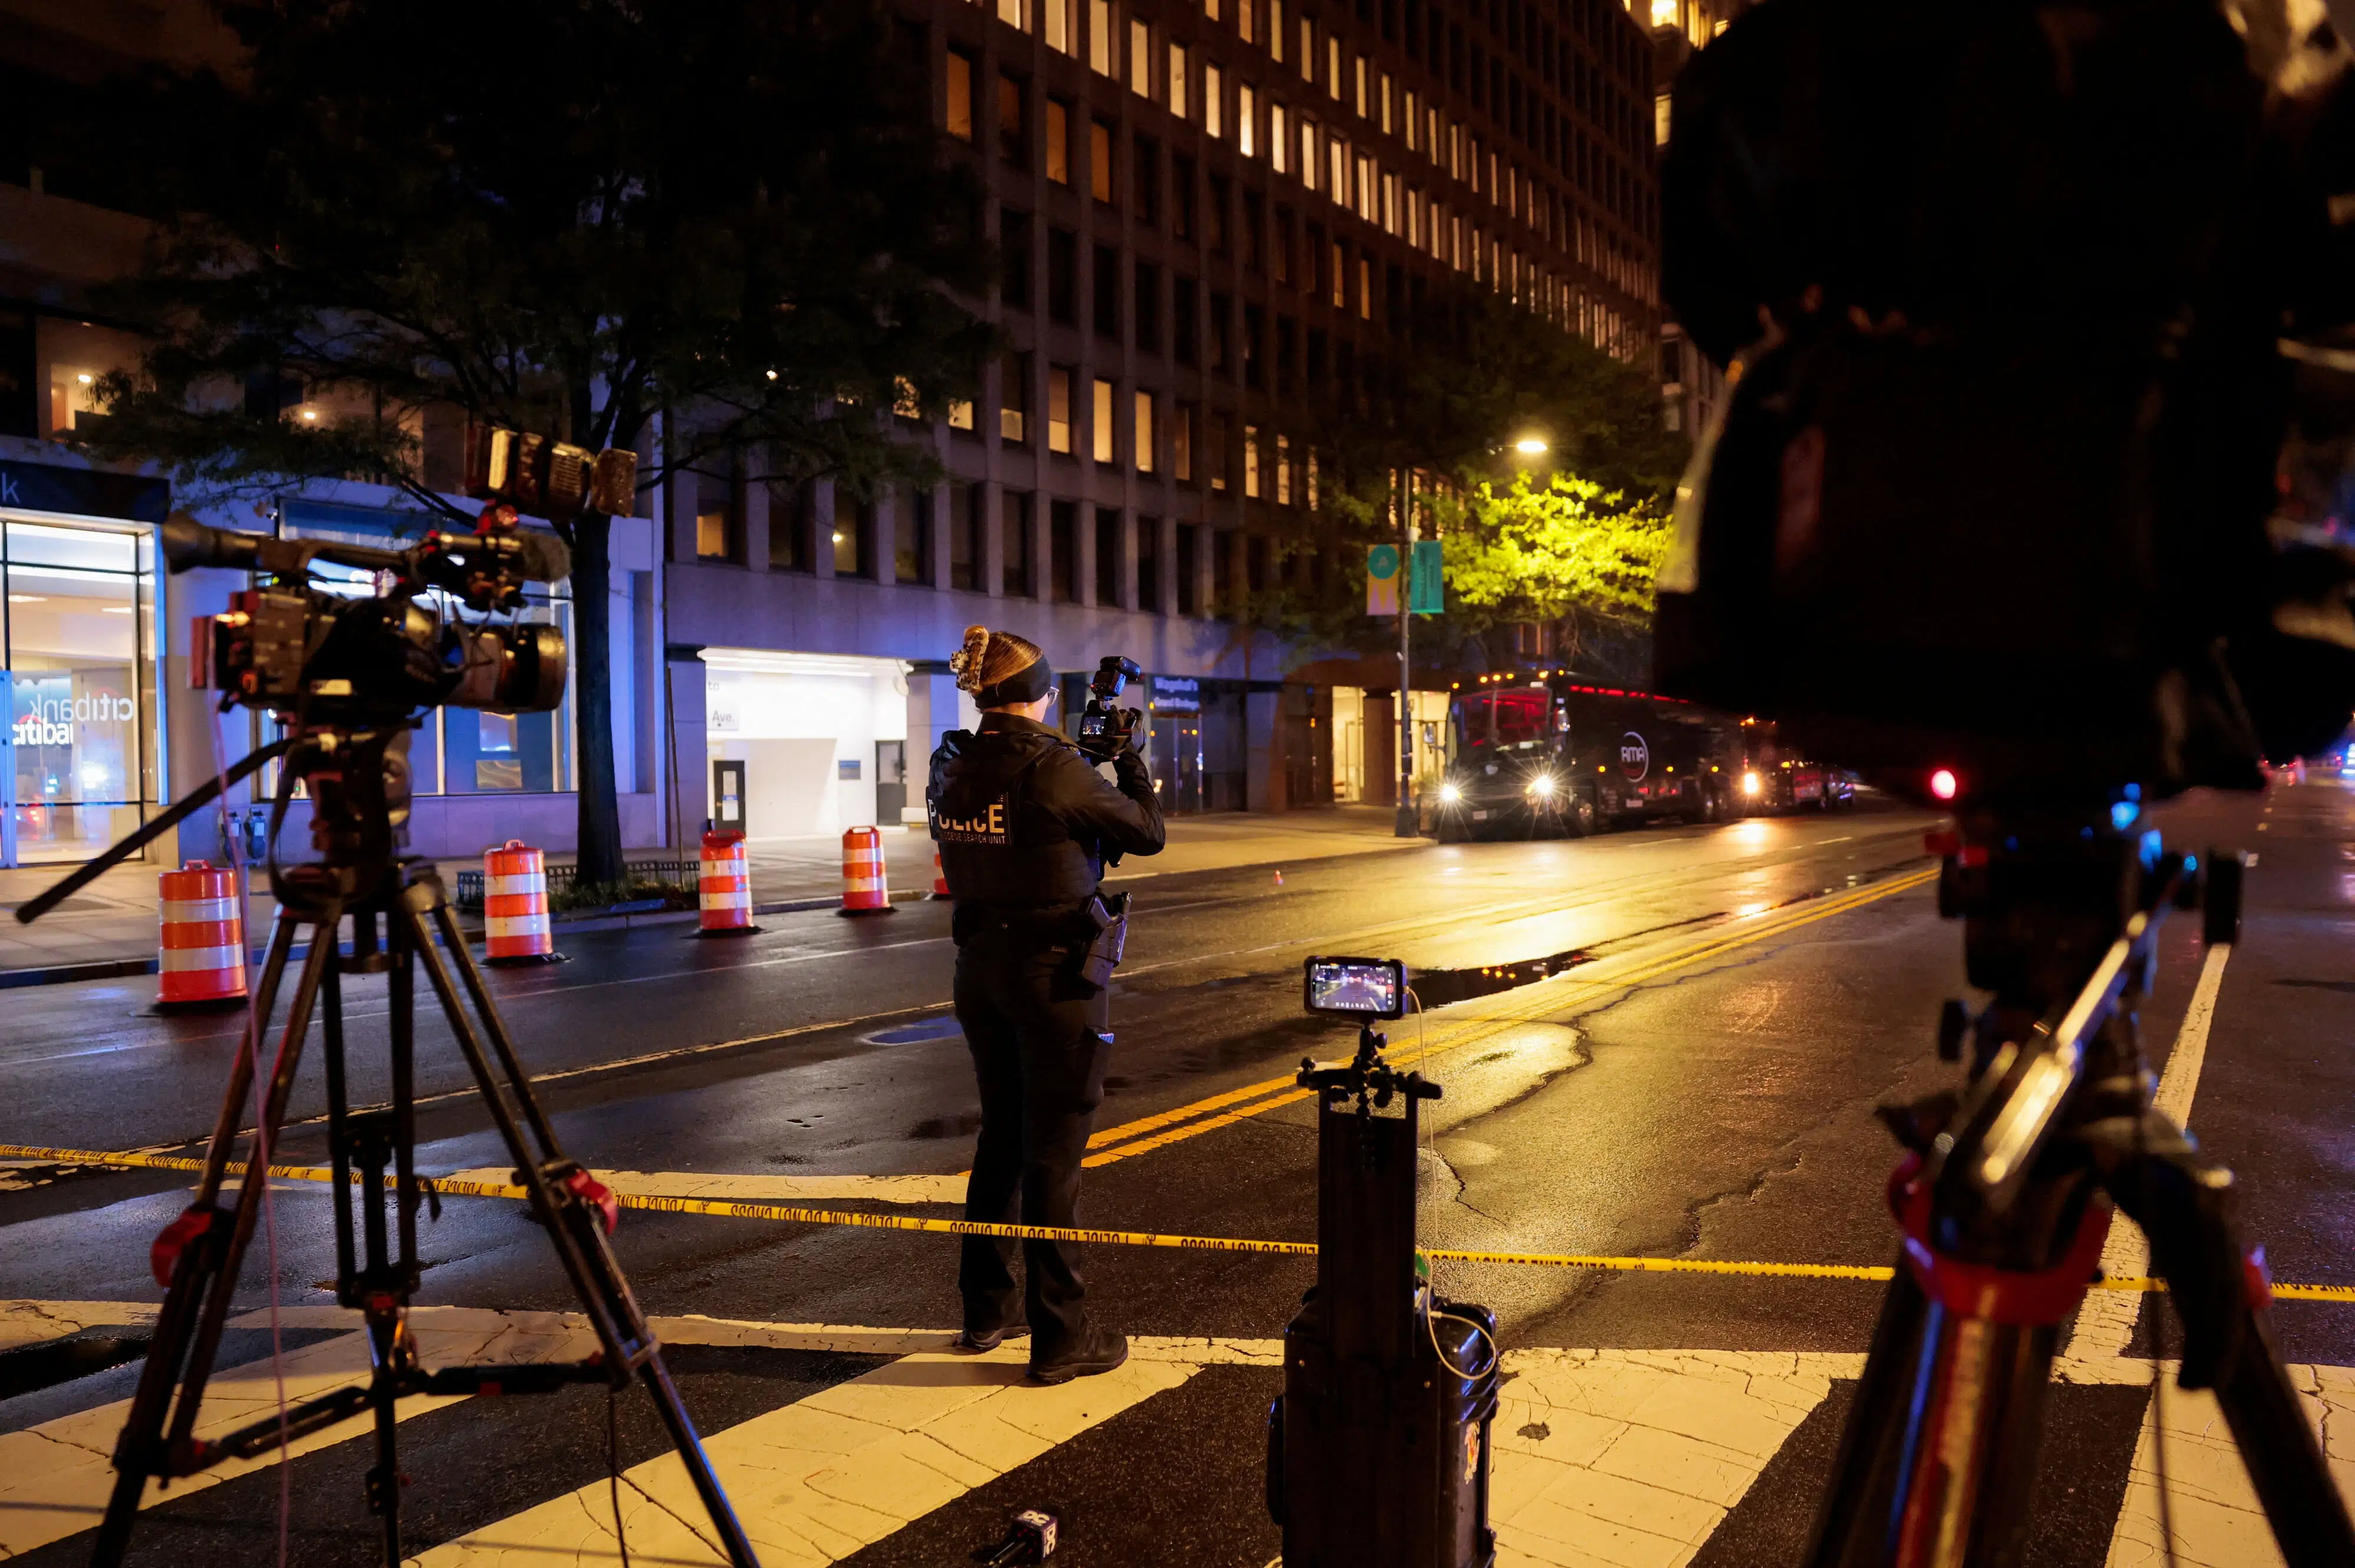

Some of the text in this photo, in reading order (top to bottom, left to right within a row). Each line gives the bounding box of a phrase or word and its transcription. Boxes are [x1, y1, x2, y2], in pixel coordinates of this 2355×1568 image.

[712, 710, 735, 722] Ave.
[963, 833, 987, 843] SEARCH
[989, 835, 1006, 844] UNIT
